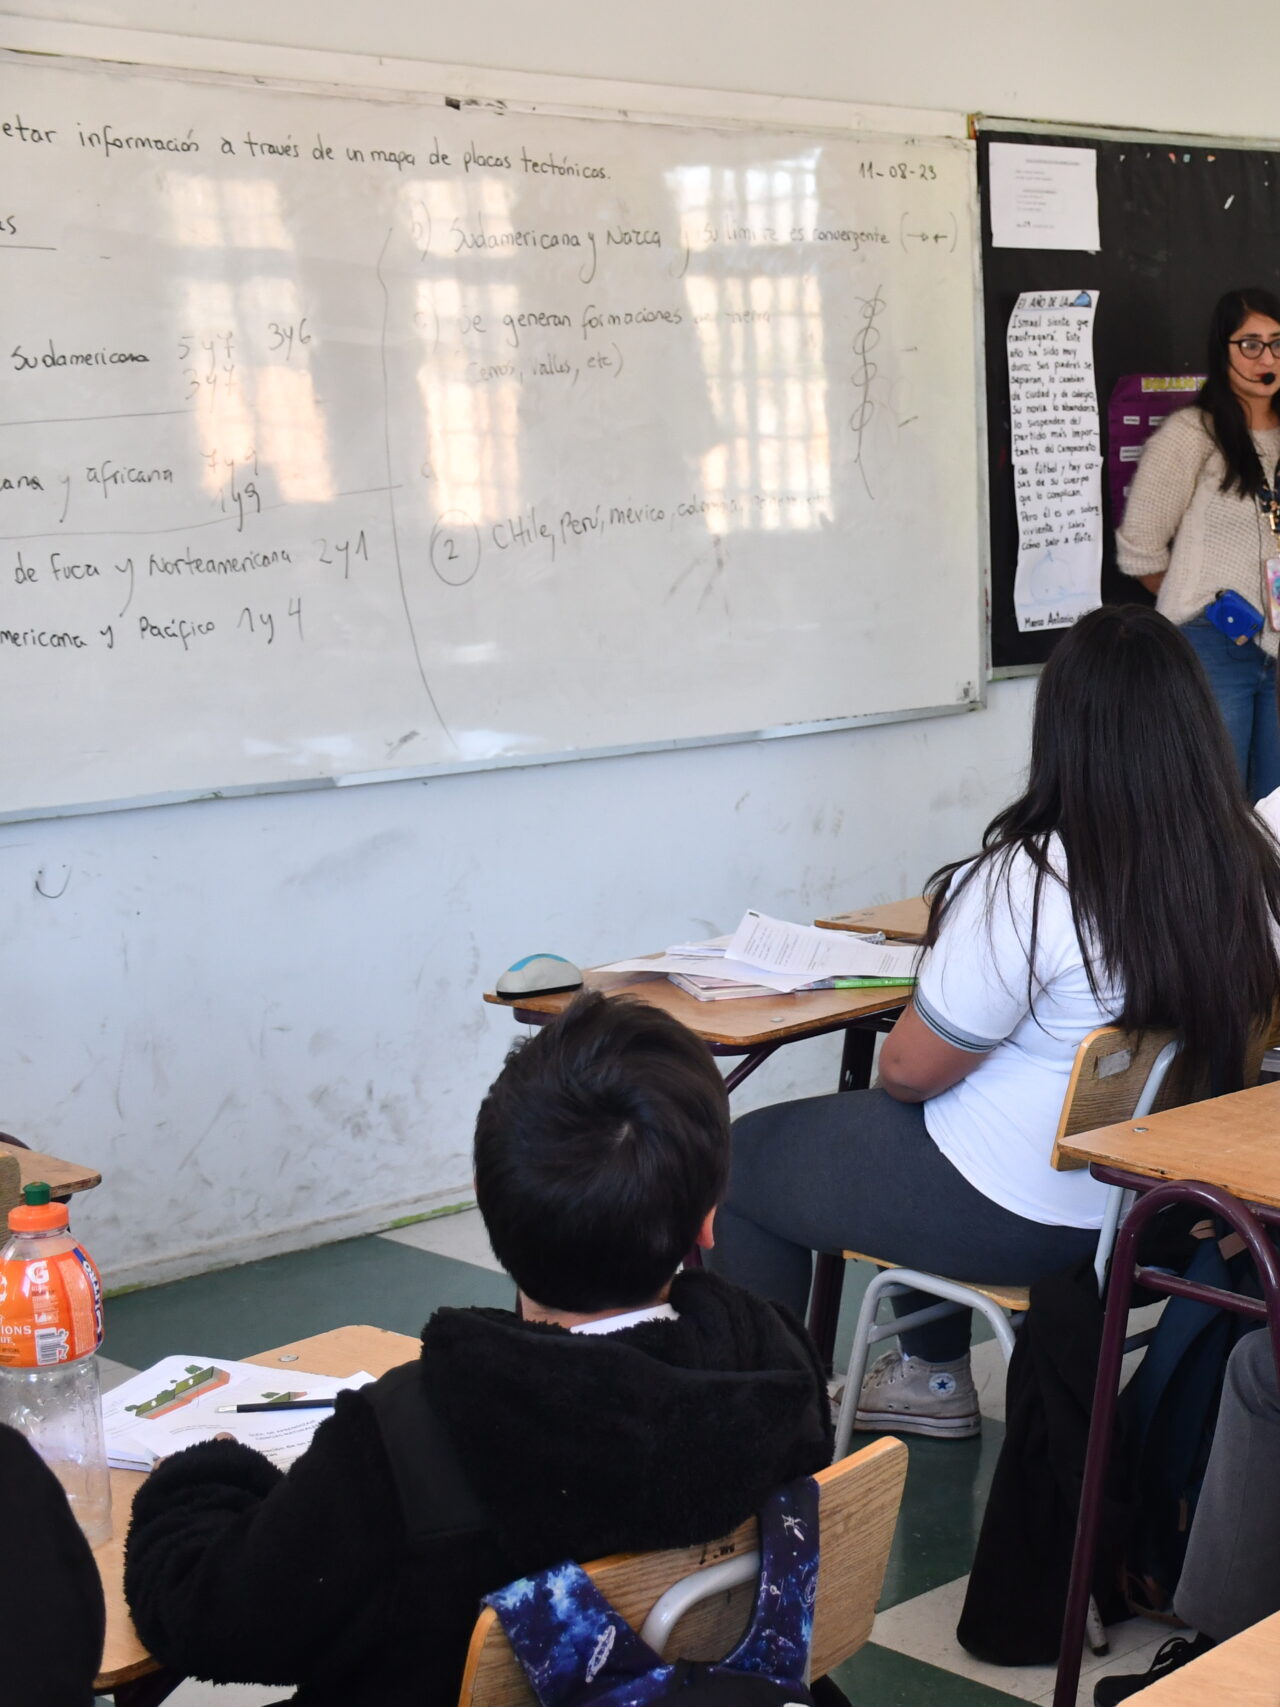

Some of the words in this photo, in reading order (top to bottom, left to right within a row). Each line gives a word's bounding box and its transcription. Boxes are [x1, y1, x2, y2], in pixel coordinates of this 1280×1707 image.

[77, 120, 200, 157] información
[220, 135, 236, 156] a
[243, 134, 300, 160] través
[312, 133, 338, 163] de
[347, 144, 368, 163] un
[369, 146, 416, 171] mapa
[429, 136, 453, 168] de
[462, 144, 512, 173] placas
[450, 210, 580, 254] Sudamericana
[578, 230, 597, 285] y
[502, 312, 572, 349] generan
[581, 304, 684, 341] formaciones
[11, 338, 150, 373] Sudamericana
[0, 475, 44, 493] ana
[60, 474, 70, 524] y
[86, 460, 174, 499] africana
[444, 538, 460, 560] 2
[15, 551, 39, 585] de
[115, 558, 134, 617] y
[149, 546, 292, 577] Norteamericana
[100, 625, 114, 650] y
[139, 616, 216, 652] Pacífico
